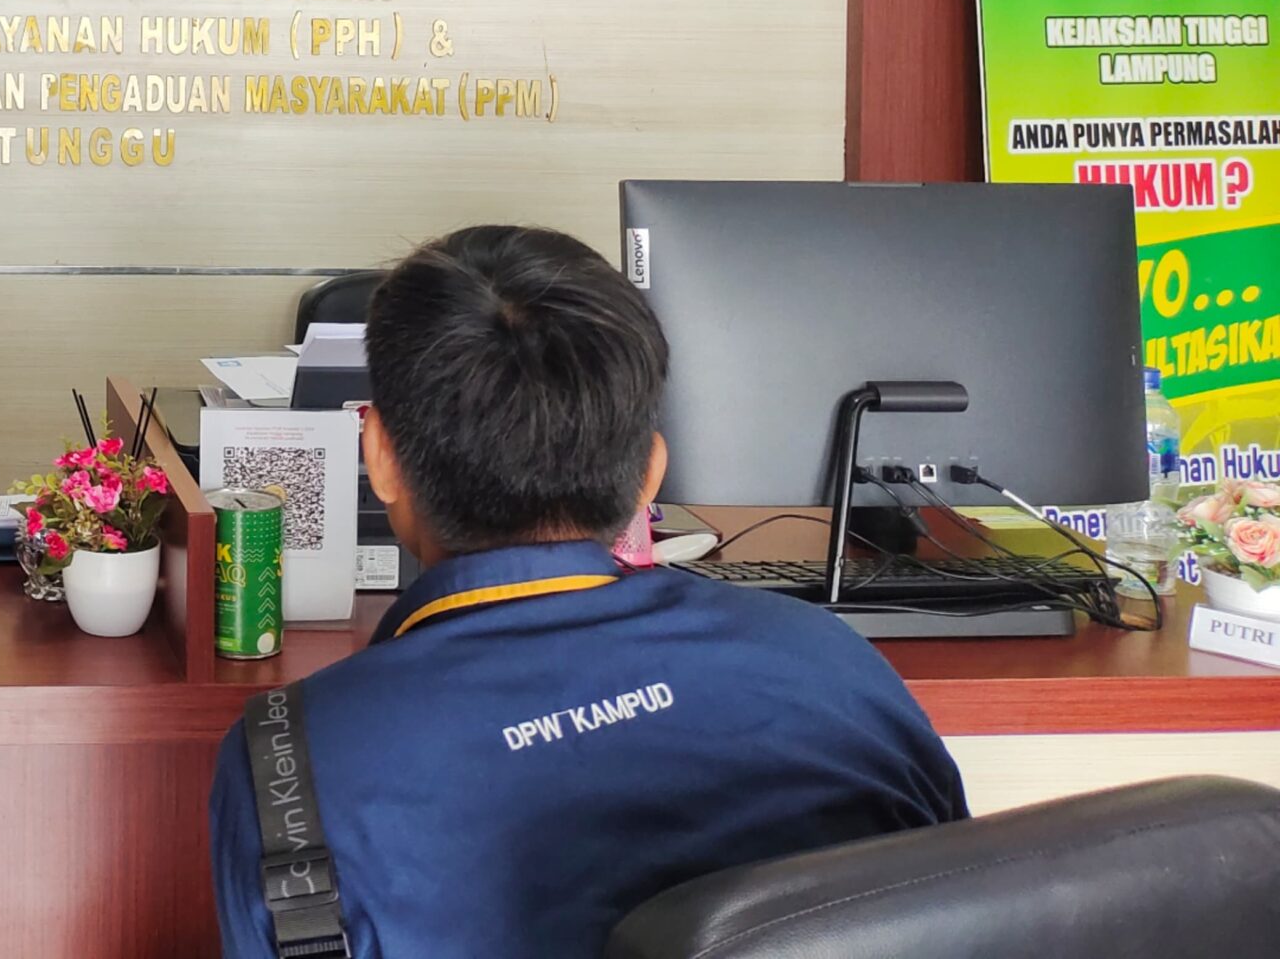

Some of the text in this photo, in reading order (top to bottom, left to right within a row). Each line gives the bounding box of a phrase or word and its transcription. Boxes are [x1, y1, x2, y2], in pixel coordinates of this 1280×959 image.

[140, 16, 270, 56] HUKUM
[429, 18, 455, 58] &
[1046, 16, 1269, 47] KEJAKSAAN TINGGI
[1099, 53, 1216, 83] LAMPUNG
[39, 72, 231, 113] PENGADUAN
[244, 75, 451, 118] MASYARAKAT
[1012, 120, 1280, 150] ANDA PUNYA PERMASALAH
[1225, 161, 1249, 205] ?
[633, 232, 645, 284] Lenovo
[1209, 618, 1274, 646] PUTRI
[502, 682, 674, 751] DPW KAMPUD
[263, 732, 301, 806] Klein
[276, 807, 315, 898] Cavin
